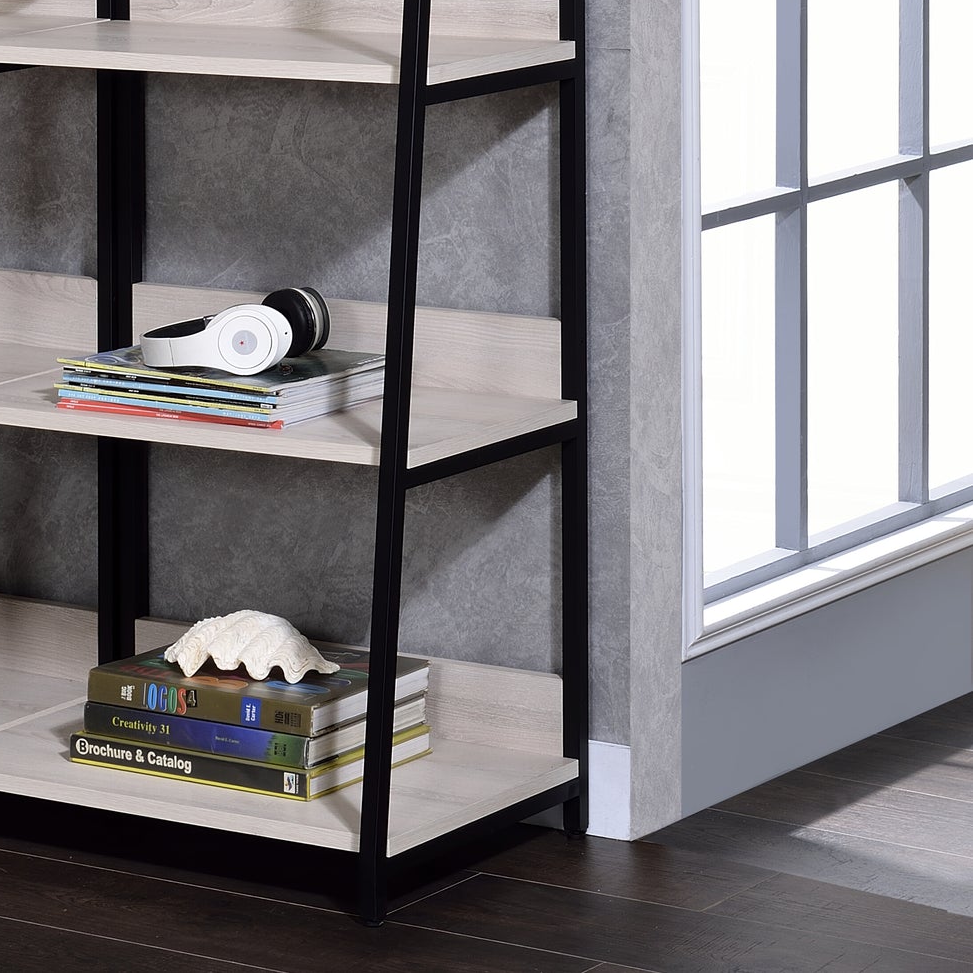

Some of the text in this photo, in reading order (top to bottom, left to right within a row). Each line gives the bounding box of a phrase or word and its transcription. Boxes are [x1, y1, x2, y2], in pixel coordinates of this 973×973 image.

[111, 715, 170, 735] Creativity 31
[75, 738, 192, 775] Brochure & Catalog
